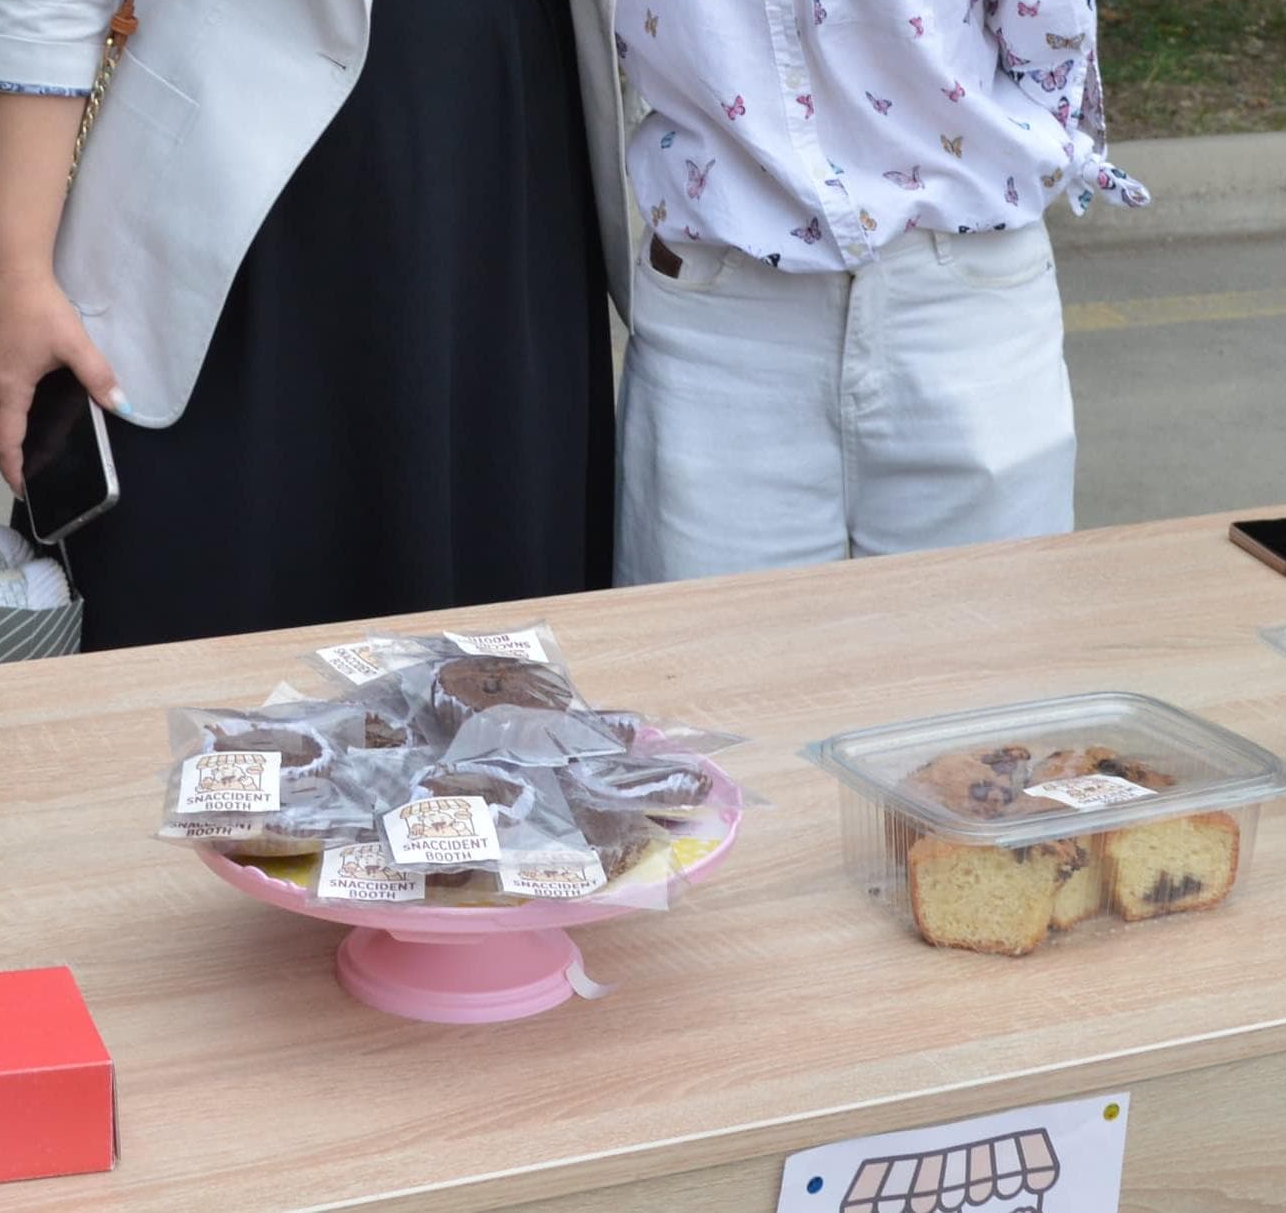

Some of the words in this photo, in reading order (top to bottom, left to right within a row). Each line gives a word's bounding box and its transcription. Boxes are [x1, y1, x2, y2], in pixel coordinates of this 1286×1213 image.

[187, 792, 272, 805] SNACCIDENT
[205, 801, 252, 811] BOOTH
[186, 826, 233, 836] BOOTH
[402, 837, 489, 852] SNACCIDENT
[425, 851, 473, 862] BOOTH
[329, 879, 417, 891] SNACCIDENT
[512, 879, 598, 890] SNACCIDENT
[349, 889, 396, 900] BOOTH
